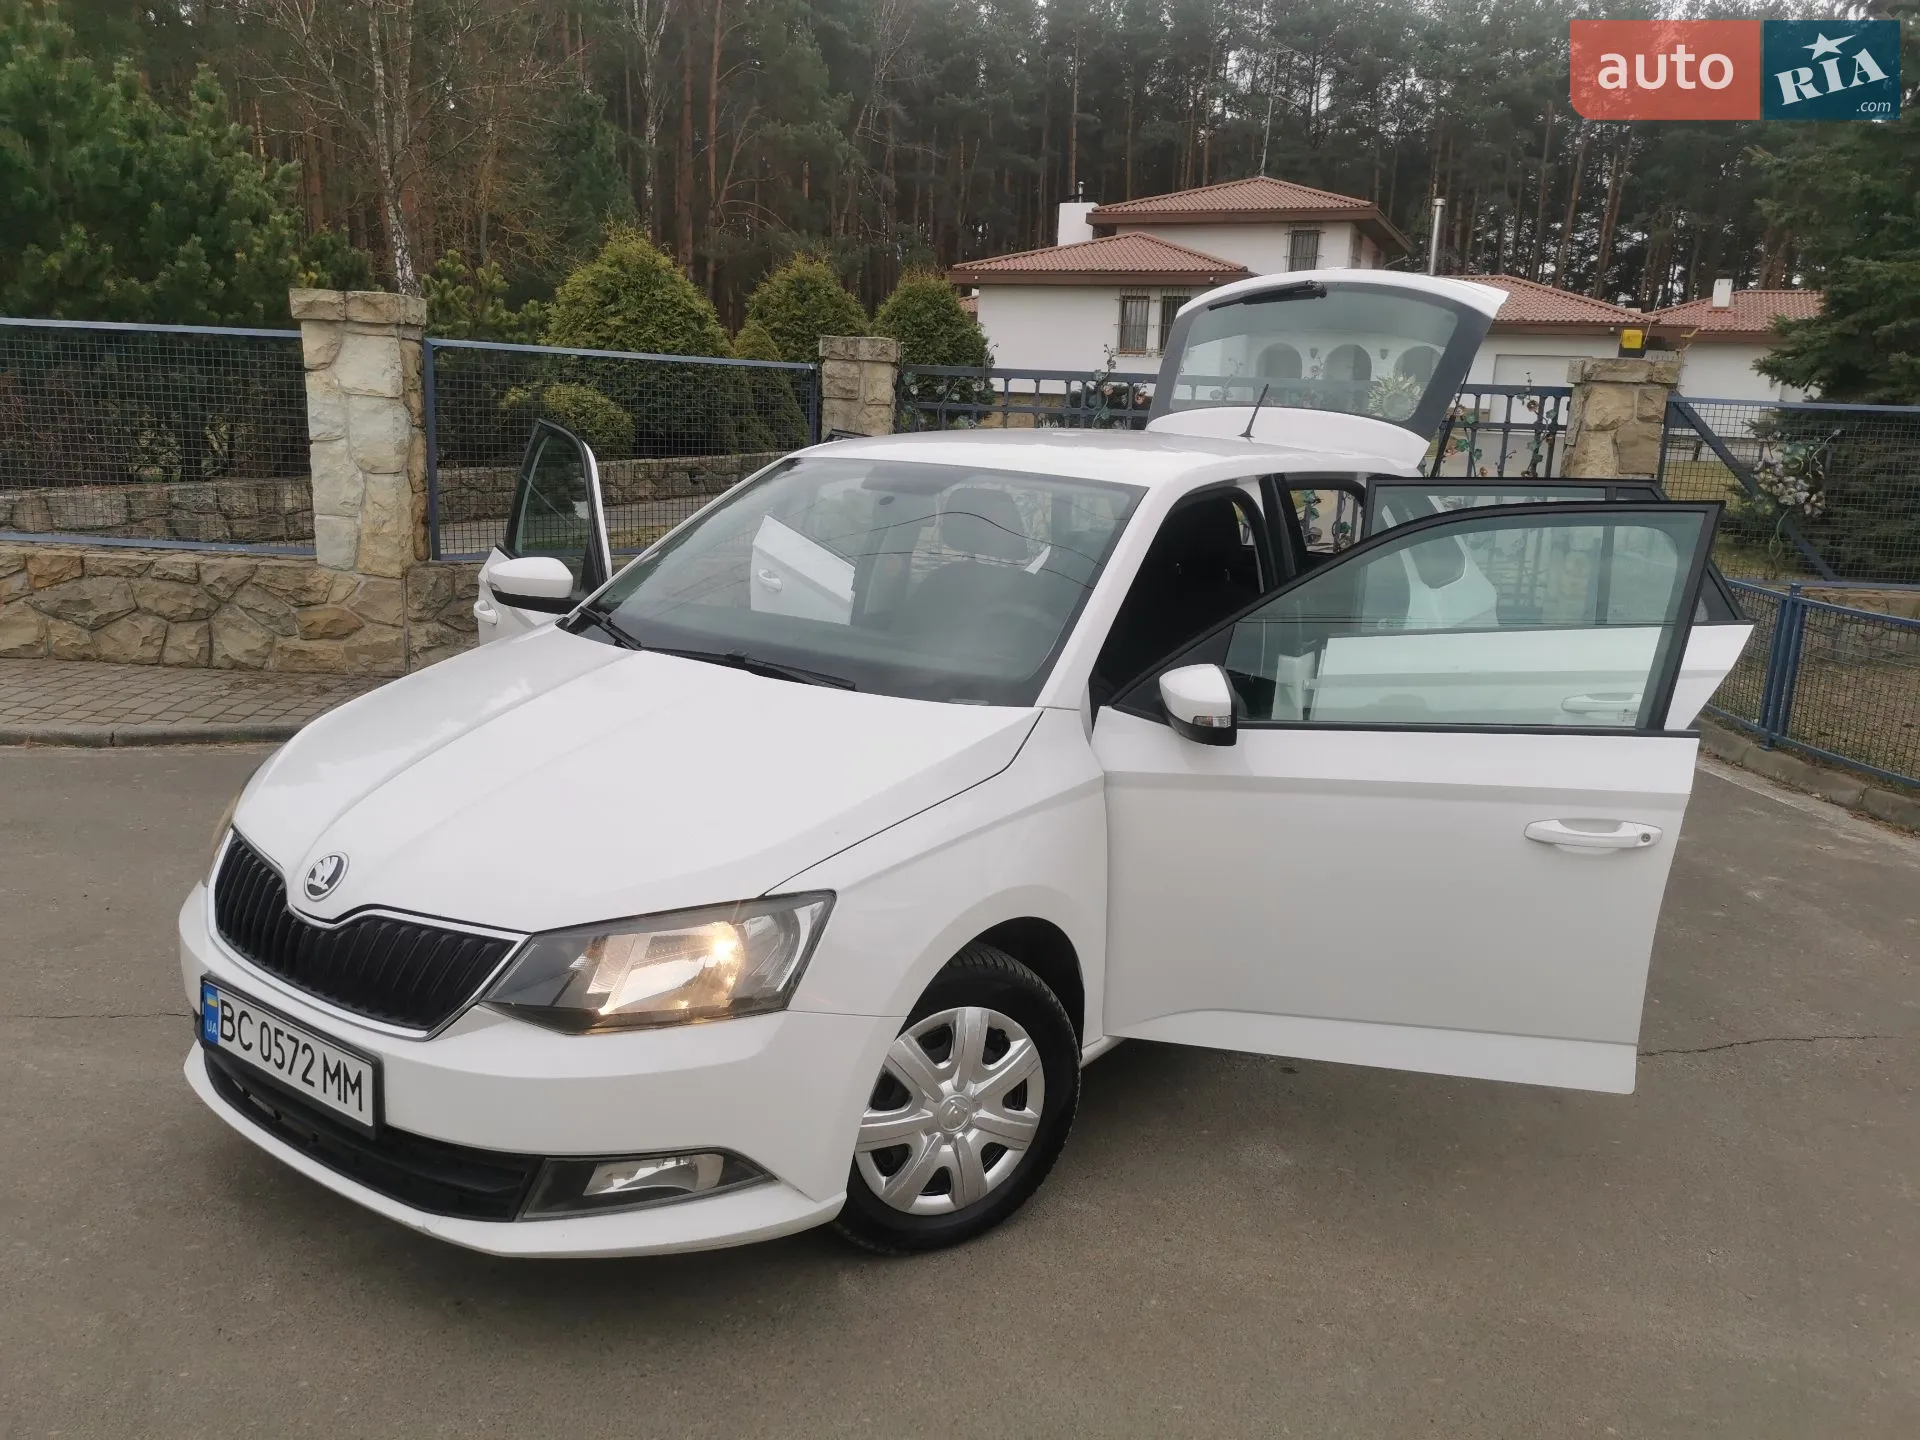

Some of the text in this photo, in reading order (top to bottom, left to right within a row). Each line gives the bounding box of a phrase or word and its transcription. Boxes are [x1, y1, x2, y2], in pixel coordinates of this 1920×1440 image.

[207, 1020, 218, 1034] UA
[220, 999, 362, 1112] BC 0572 MM
